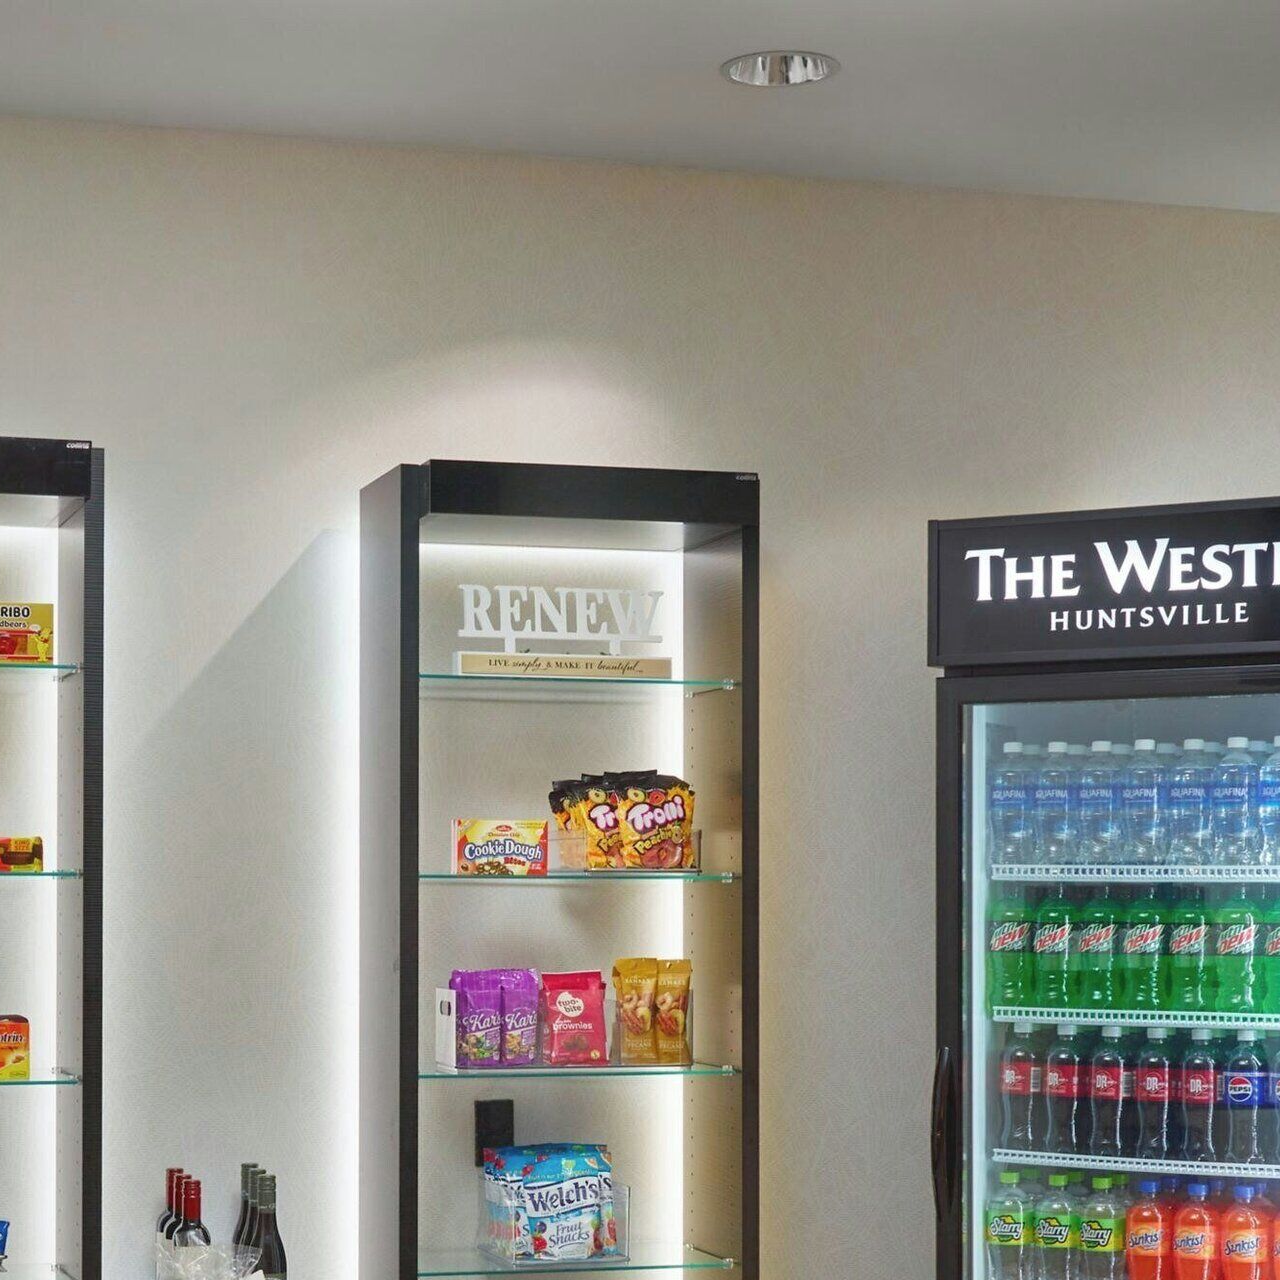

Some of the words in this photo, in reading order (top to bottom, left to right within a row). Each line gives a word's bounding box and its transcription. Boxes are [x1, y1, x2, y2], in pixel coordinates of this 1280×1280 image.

[964, 547, 1080, 601] THE
[458, 584, 665, 640] RENEW
[1050, 602, 1250, 631] HUNTSVILLE
[488, 658, 509, 667] LIVE
[554, 661, 581, 669] MAKE
[626, 795, 685, 831] Trolli
[564, 1004, 582, 1013] bite
[552, 1021, 593, 1031] brownies
[1228, 1086, 1252, 1094] PEPSI
[526, 1180, 599, 1212] Welch's
[549, 1231, 590, 1248] Snacks
[990, 1215, 1023, 1240] Starry
[1037, 1218, 1070, 1243] Starry
[1080, 1221, 1113, 1247] Starry
[1224, 1237, 1260, 1256] Sunkist
